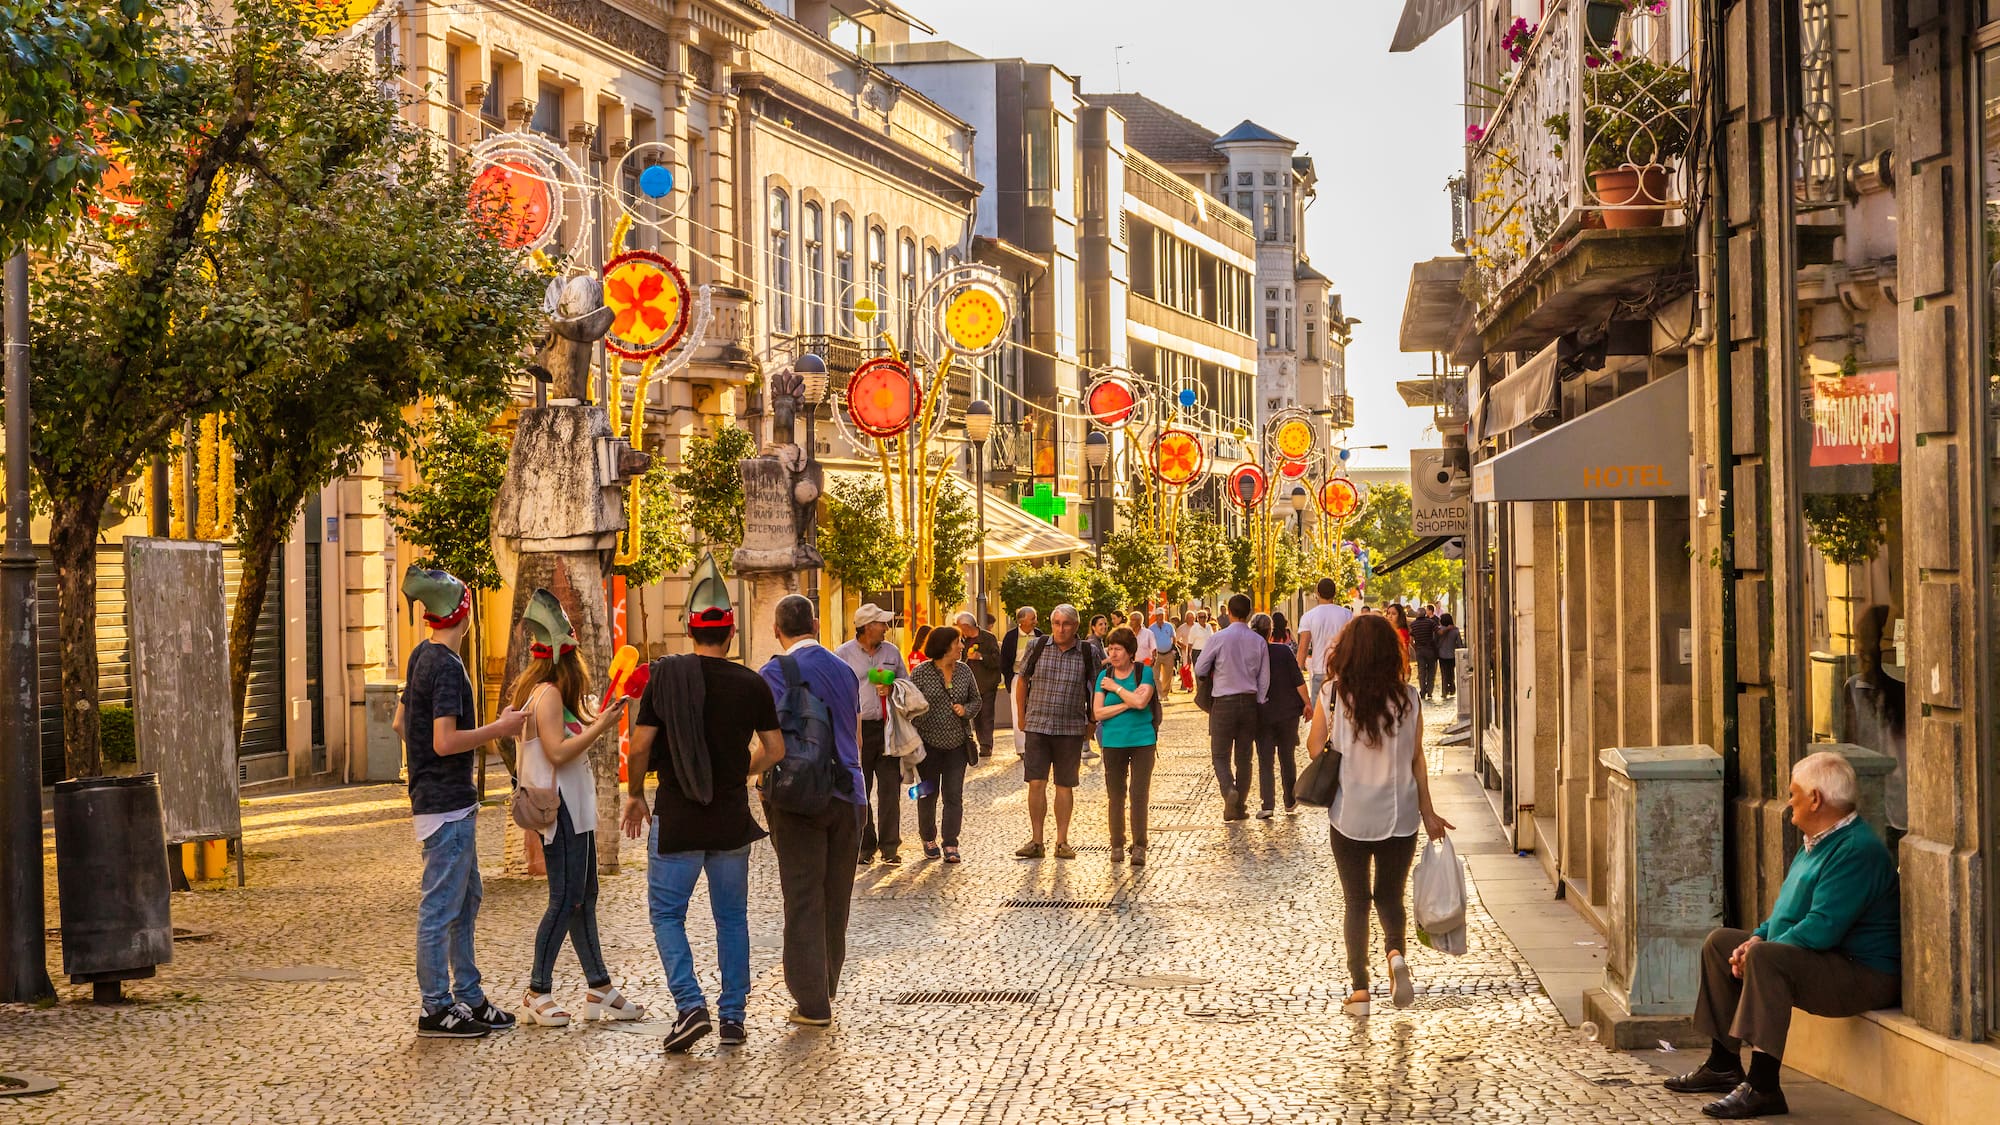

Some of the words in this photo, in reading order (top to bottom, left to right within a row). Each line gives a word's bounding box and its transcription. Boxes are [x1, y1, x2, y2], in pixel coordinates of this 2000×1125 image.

[1814, 383, 1896, 459] PROMOÇÕES
[1583, 464, 1672, 488] HOTEL
[1416, 507, 1468, 519] ALAMED
[1416, 520, 1468, 533] SHOPPIN
[440, 1014, 462, 1029] N
